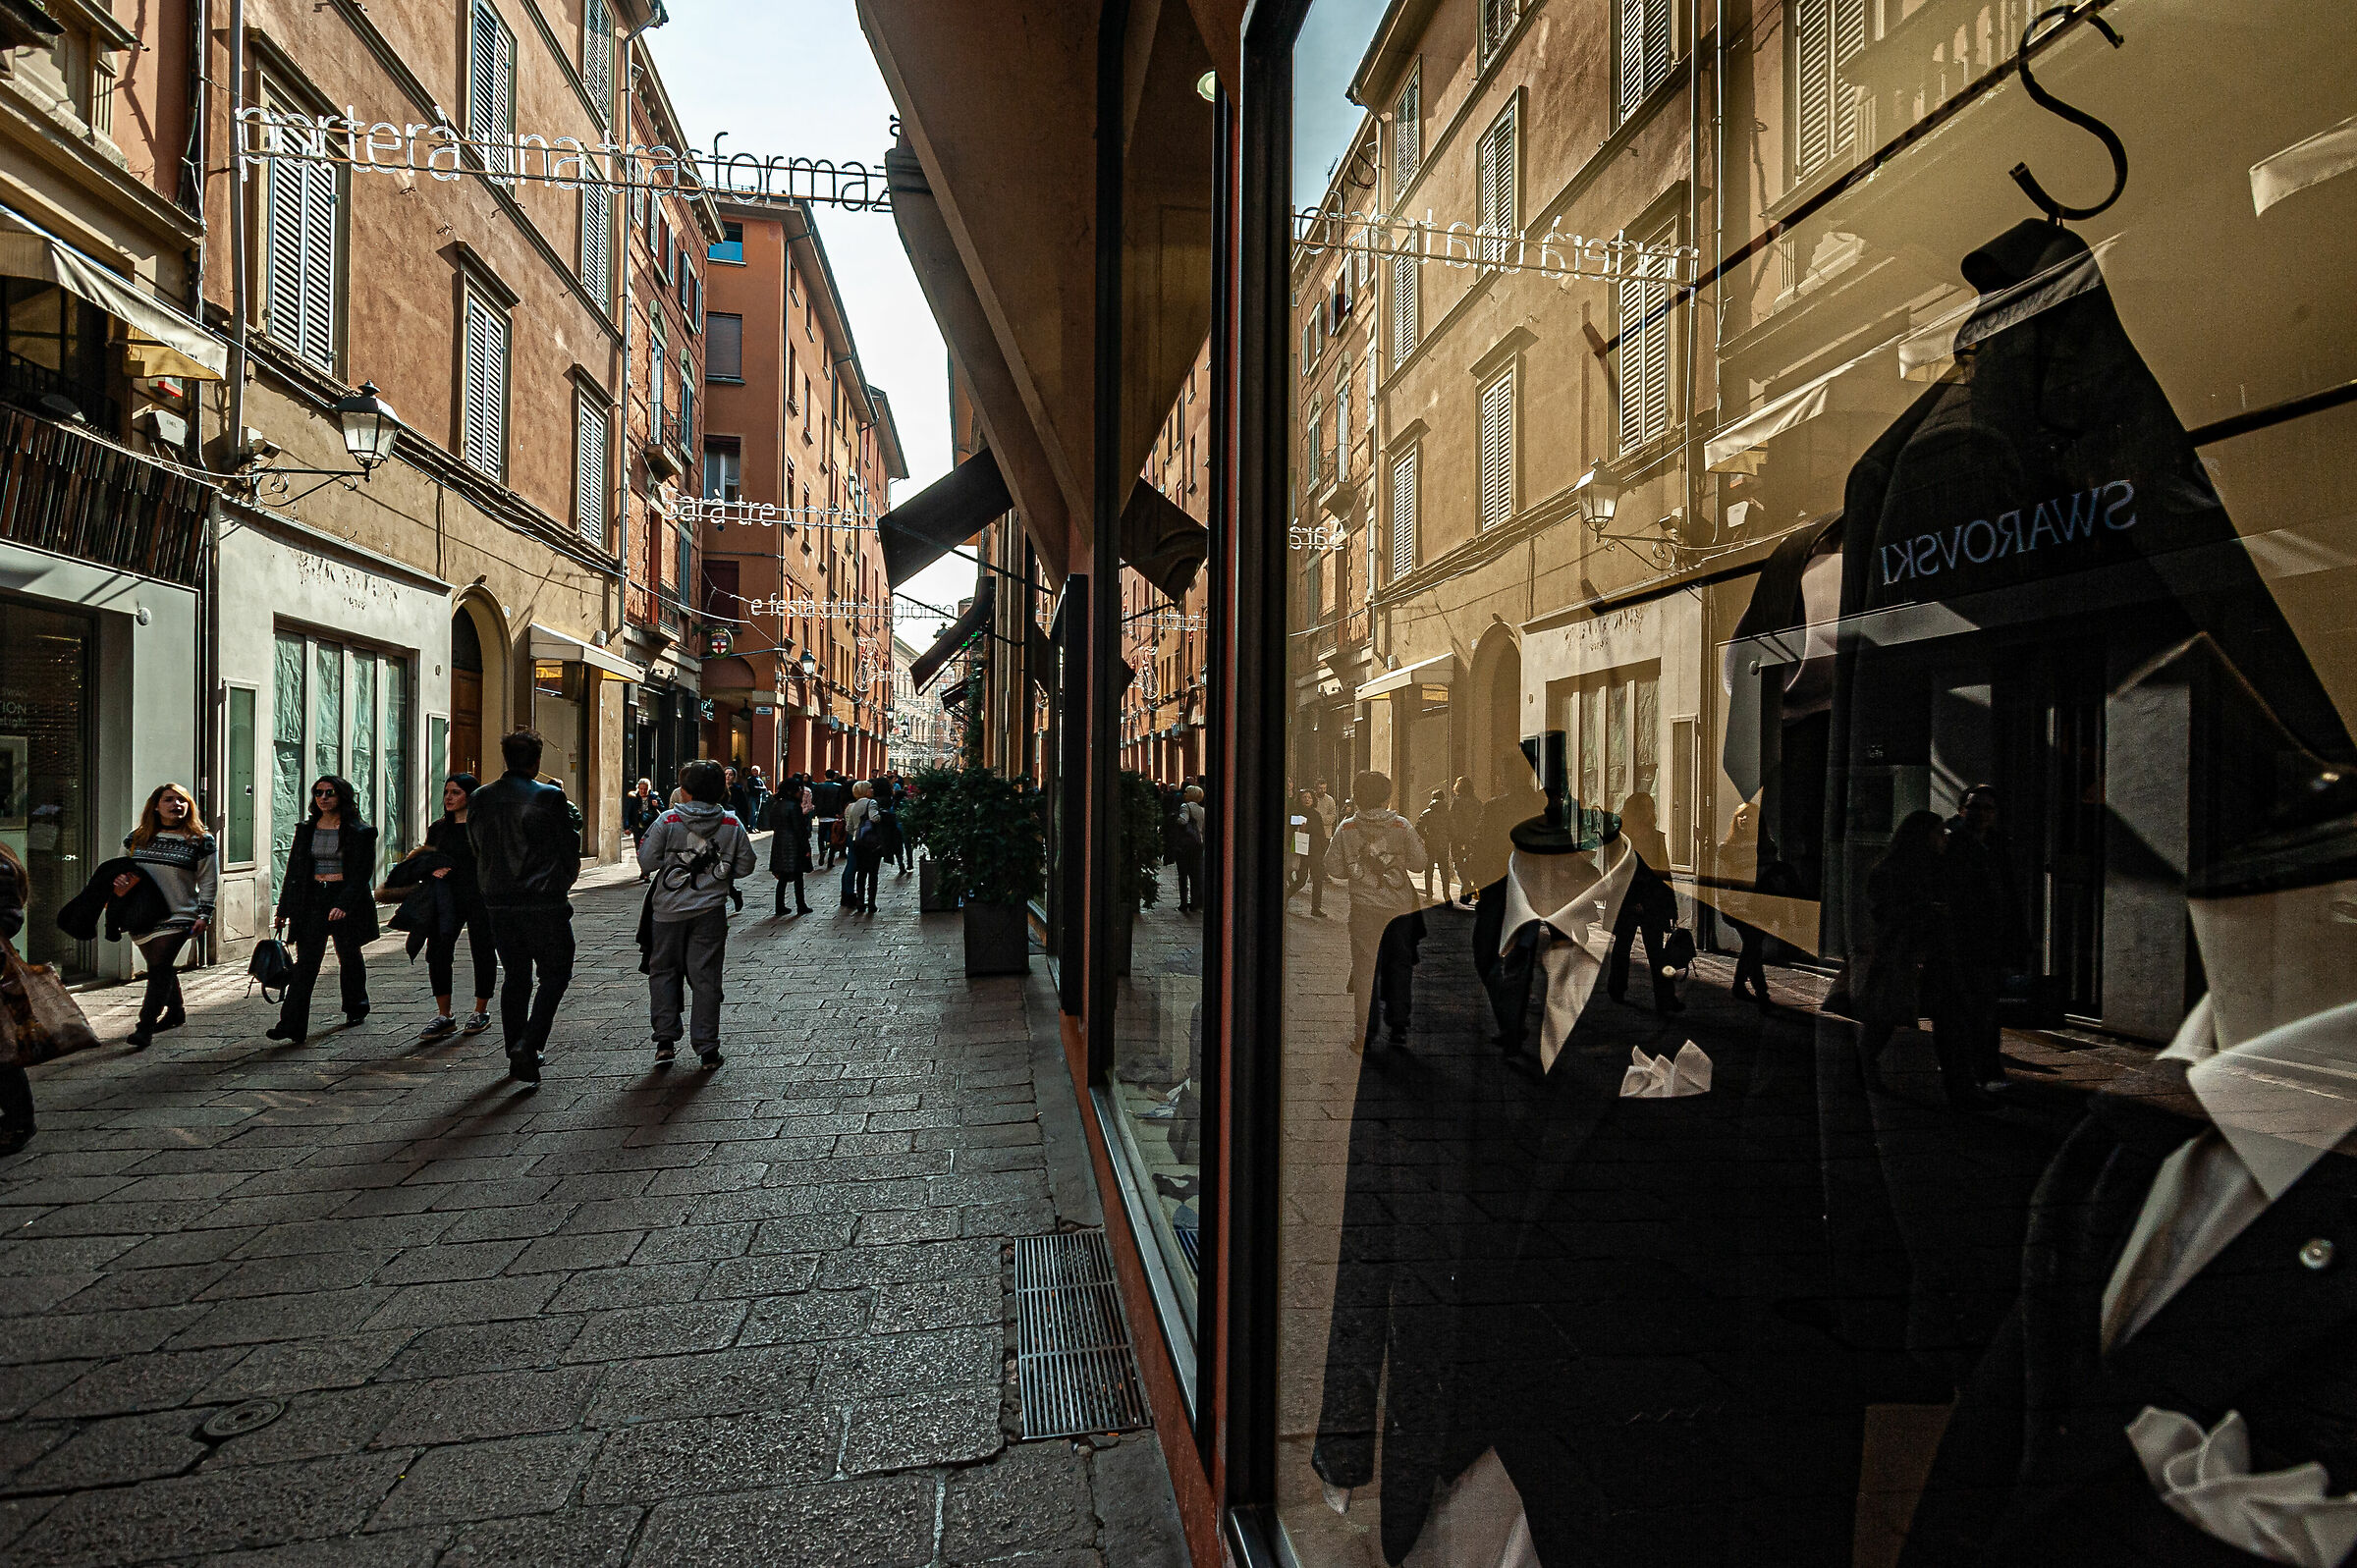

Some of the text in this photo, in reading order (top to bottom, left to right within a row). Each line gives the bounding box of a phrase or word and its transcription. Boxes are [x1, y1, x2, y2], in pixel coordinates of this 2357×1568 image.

[234, 104, 461, 183] porterà
[483, 131, 586, 190] una
[660, 486, 726, 524] sarà
[734, 494, 777, 527] tre
[750, 598, 763, 617] e
[767, 592, 815, 618] festa
[821, 596, 869, 620] tutto
